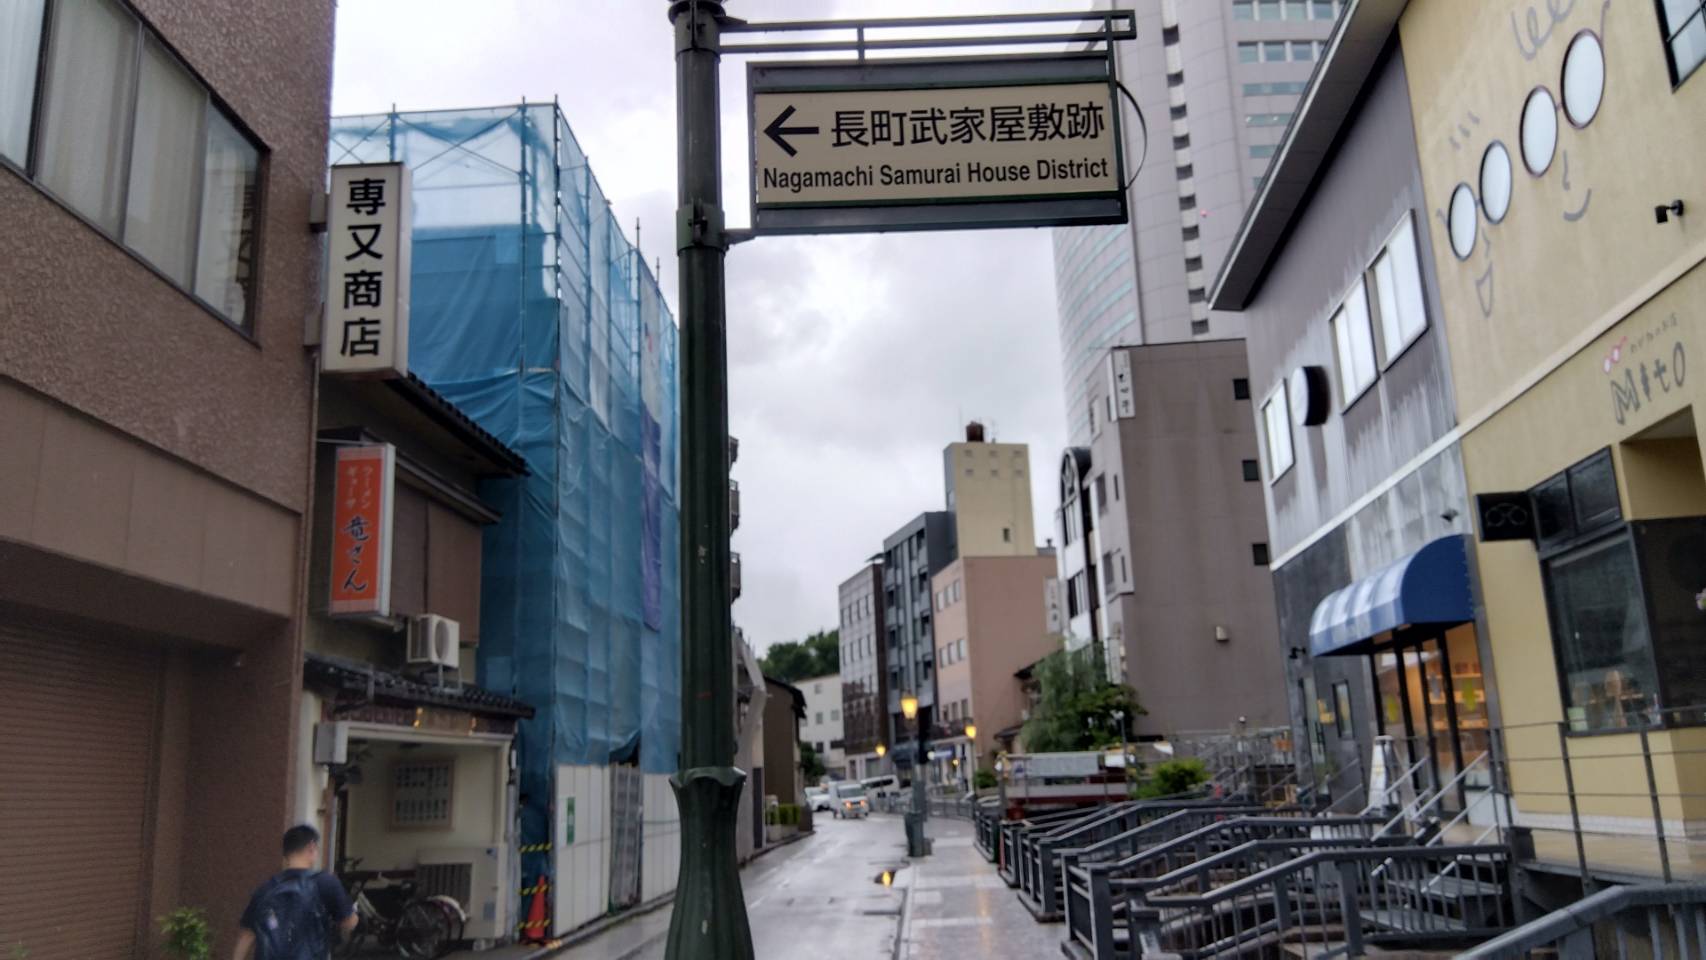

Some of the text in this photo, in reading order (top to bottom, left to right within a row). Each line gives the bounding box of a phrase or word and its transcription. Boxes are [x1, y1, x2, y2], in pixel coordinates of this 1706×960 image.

[831, 101, 1105, 147] 長町武家屋敷跡
[764, 158, 1109, 193] Nagamachi Samurai House District
[340, 178, 386, 357] 専又商店
